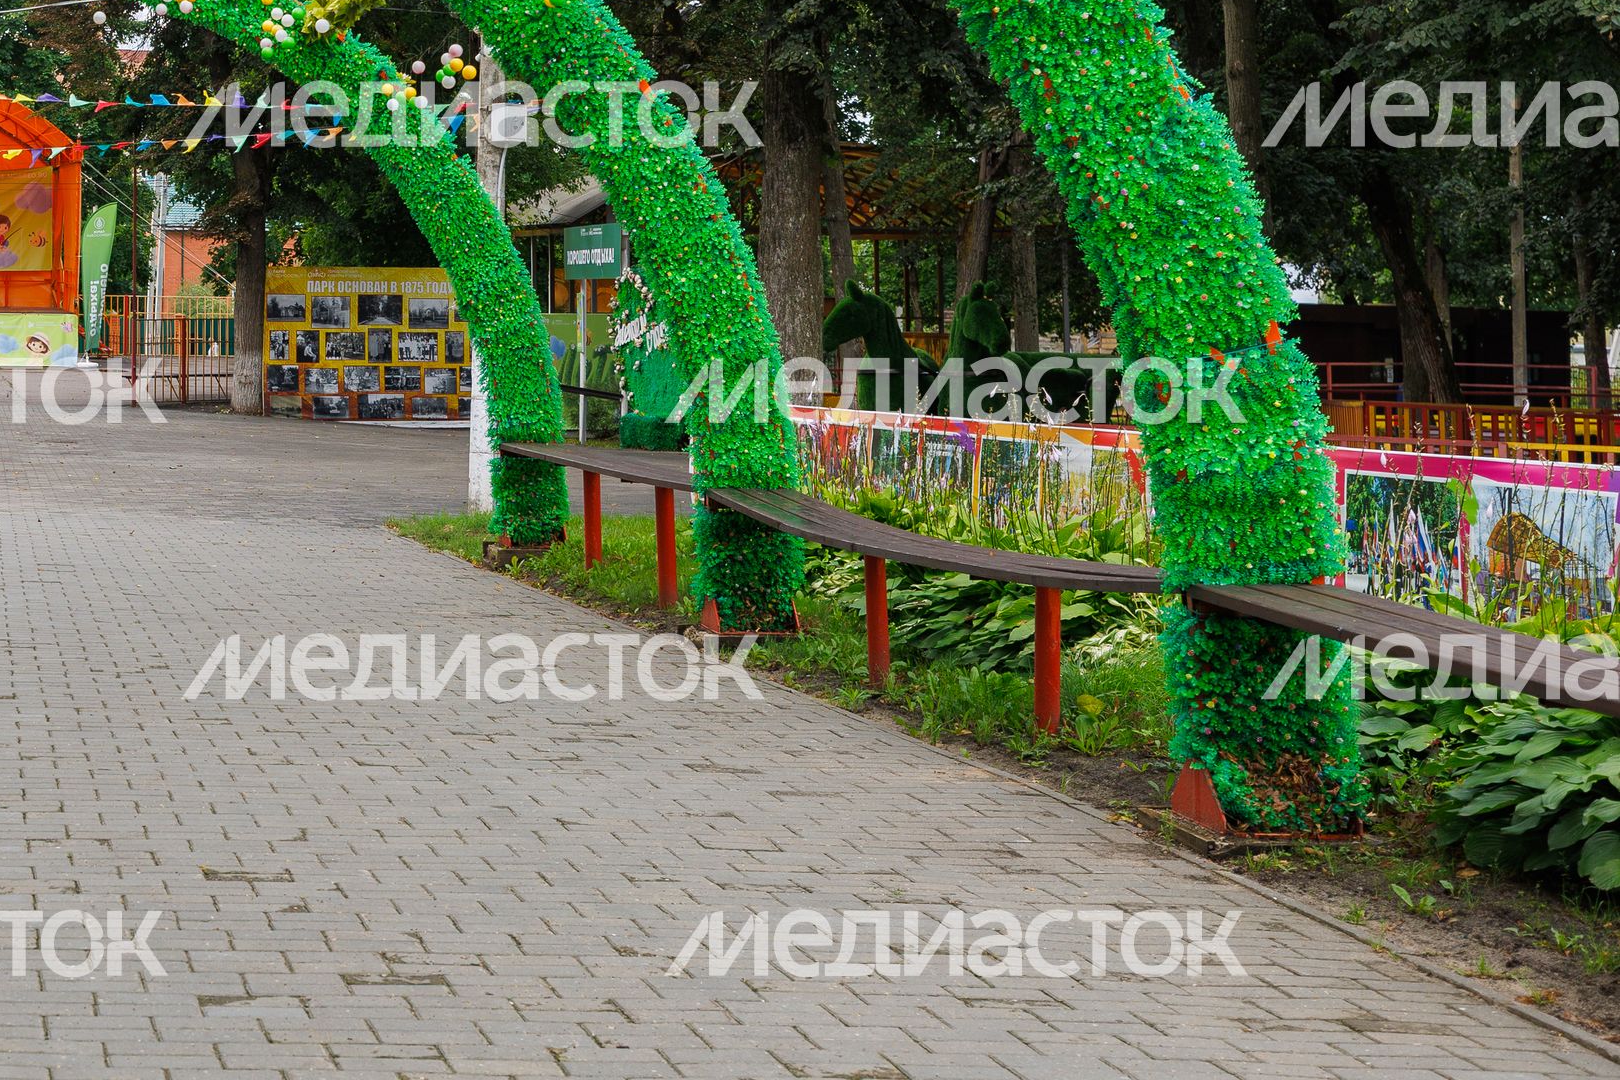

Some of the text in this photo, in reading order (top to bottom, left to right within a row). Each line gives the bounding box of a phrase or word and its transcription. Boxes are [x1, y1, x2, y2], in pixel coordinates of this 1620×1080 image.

[307, 281, 335, 293] ПАРК
[337, 281, 388, 293] ОСНОВАН
[390, 281, 398, 293] В
[400, 281, 424, 294] 1875
